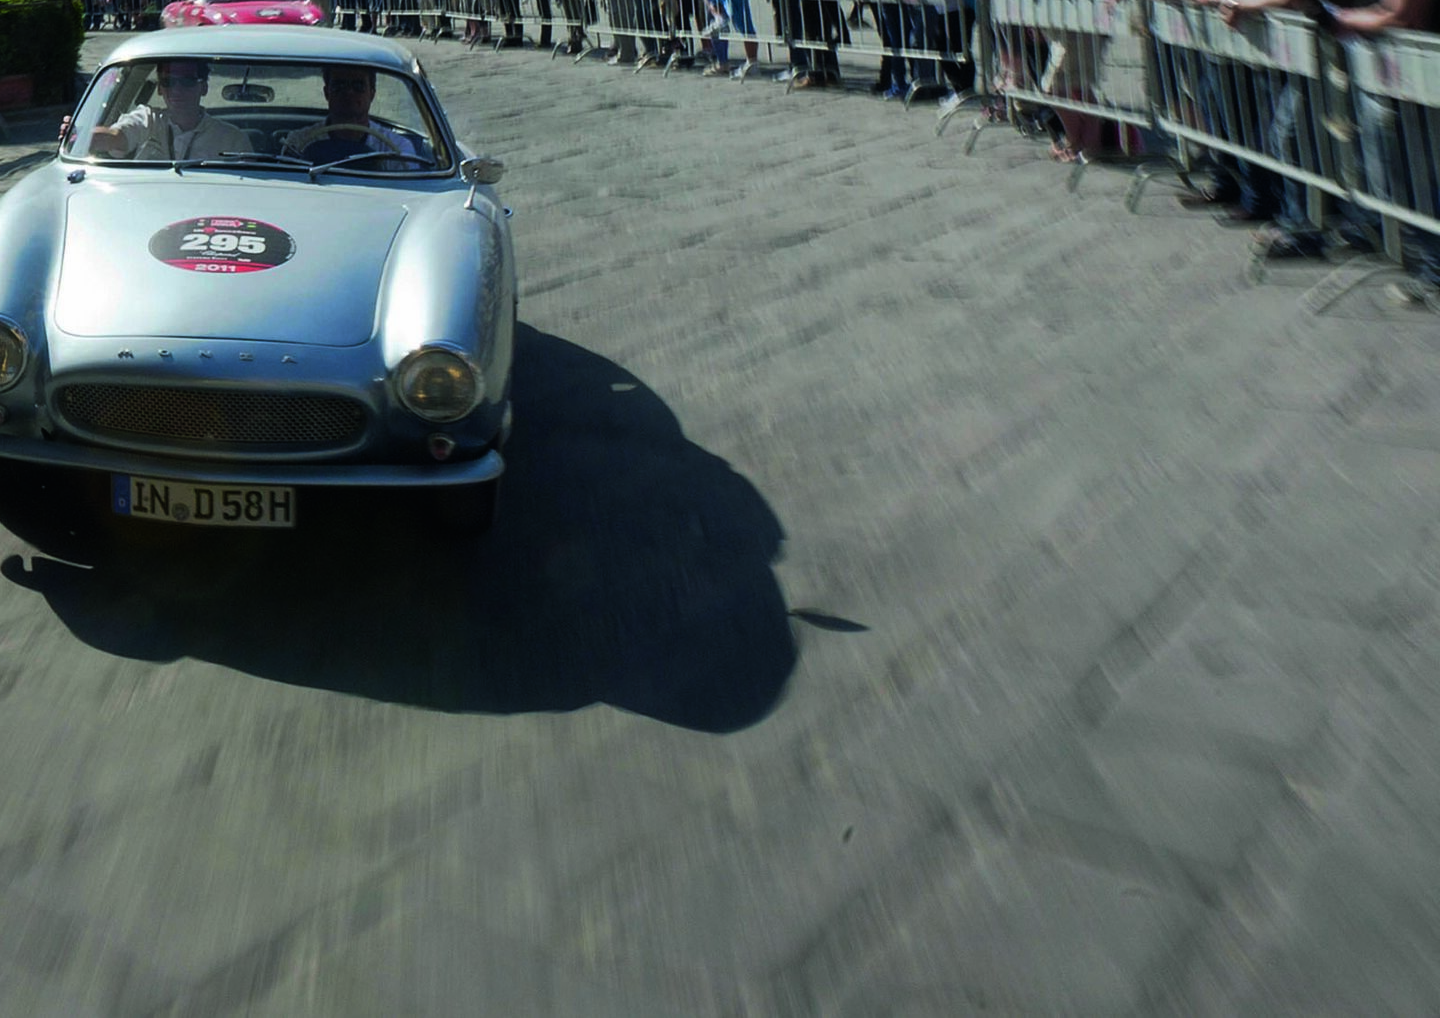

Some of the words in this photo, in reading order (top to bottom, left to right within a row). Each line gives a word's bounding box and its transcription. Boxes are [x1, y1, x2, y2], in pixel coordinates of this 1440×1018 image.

[180, 234, 266, 254] 295
[194, 264, 237, 272] 2011
[117, 348, 299, 365] MONZA
